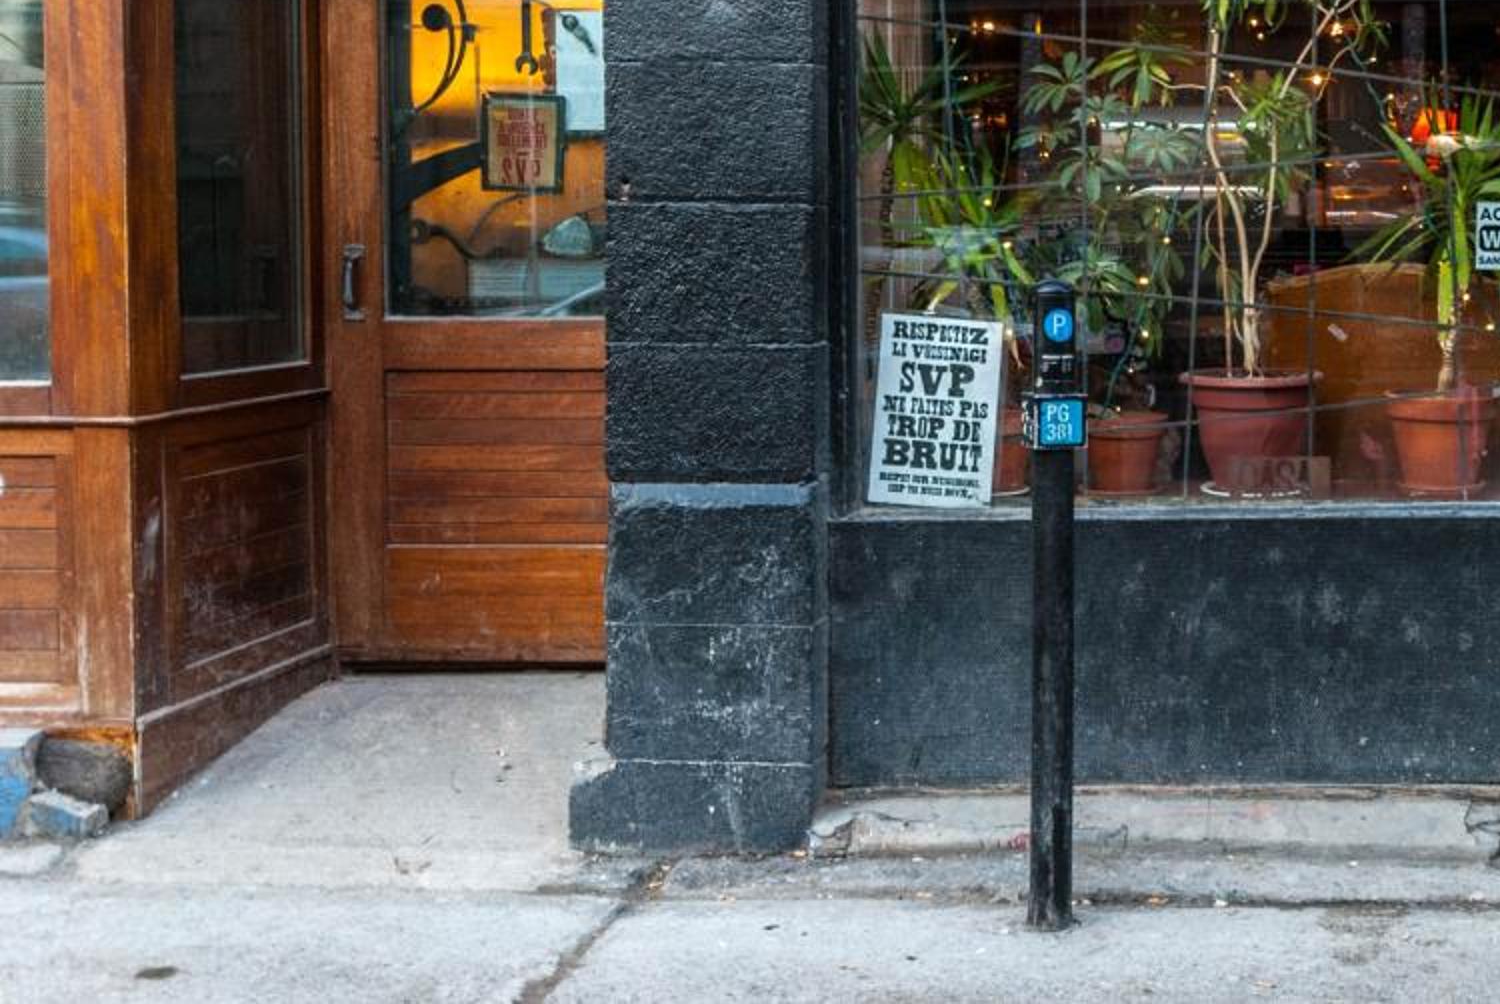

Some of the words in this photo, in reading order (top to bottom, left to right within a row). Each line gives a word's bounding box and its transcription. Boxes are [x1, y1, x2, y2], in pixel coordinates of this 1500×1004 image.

[892, 320, 989, 346] RESPECTEZ
[899, 361, 975, 398] SVP
[911, 397, 955, 417] FAITES
[958, 400, 989, 419] PAS
[1046, 404, 1070, 423] PG
[888, 413, 945, 440] TROP
[952, 419, 981, 443] DE
[882, 438, 983, 474] BRUIT
